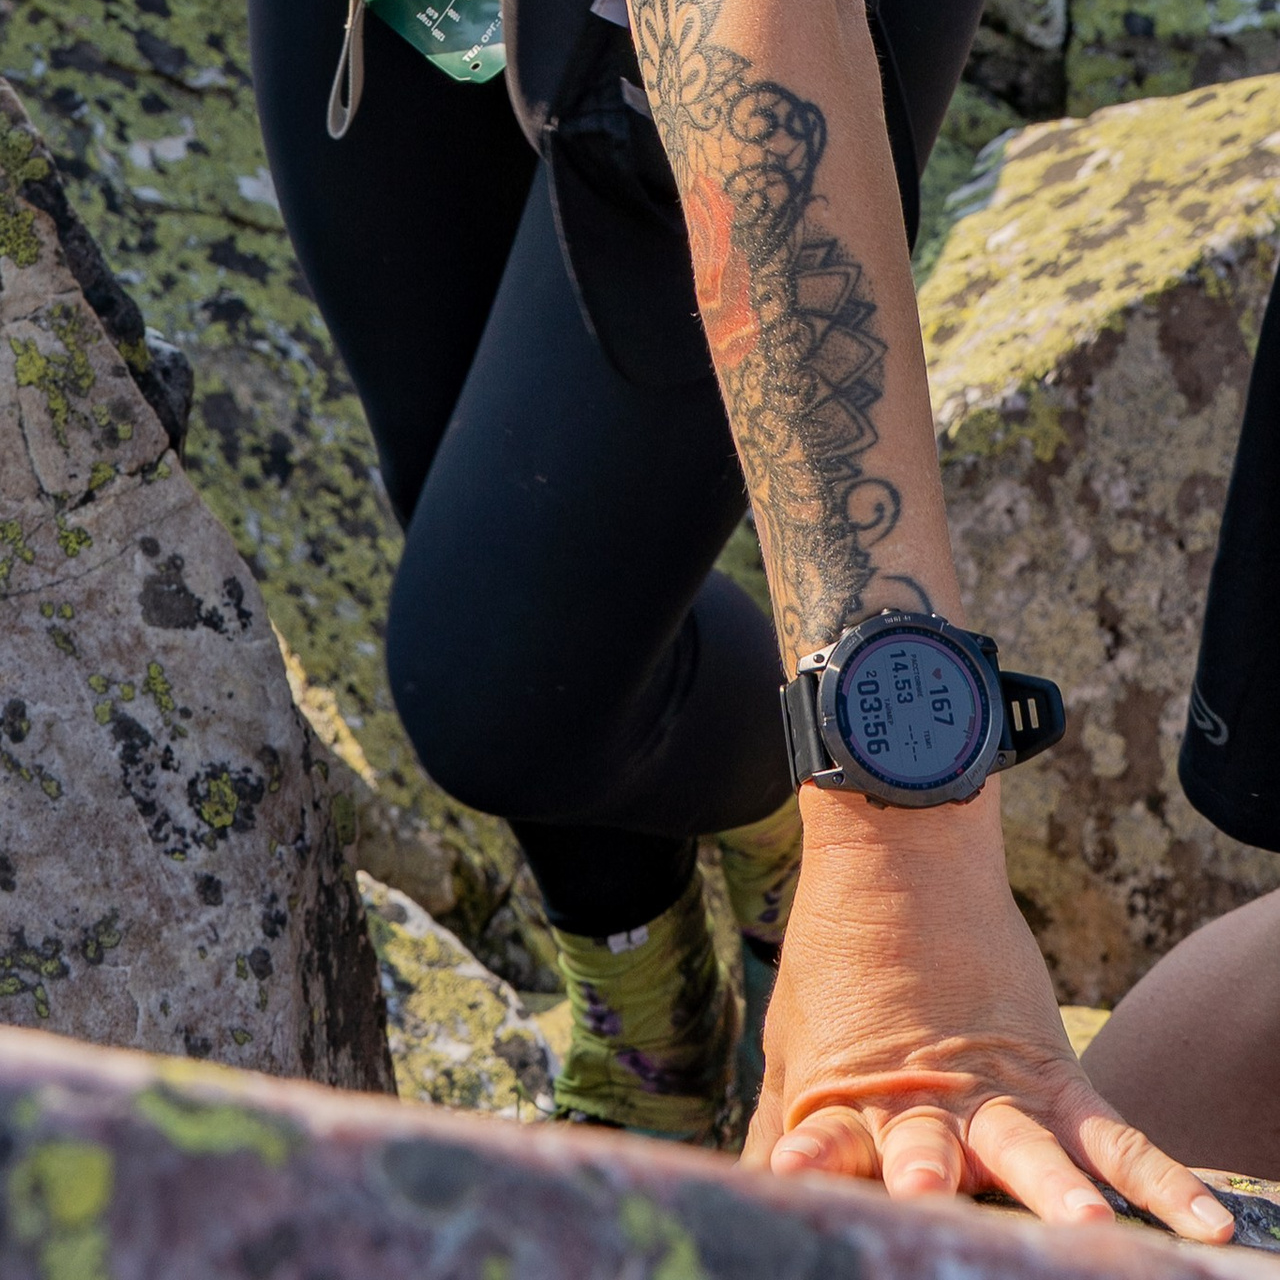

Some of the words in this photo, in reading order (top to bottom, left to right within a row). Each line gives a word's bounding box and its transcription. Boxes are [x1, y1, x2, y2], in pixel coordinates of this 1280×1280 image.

[417, 13, 432, 26] старт
[462, 41, 483, 63] ТЕЛ.
[890, 650, 913, 704] 14.53
[929, 685, 955, 727] 167
